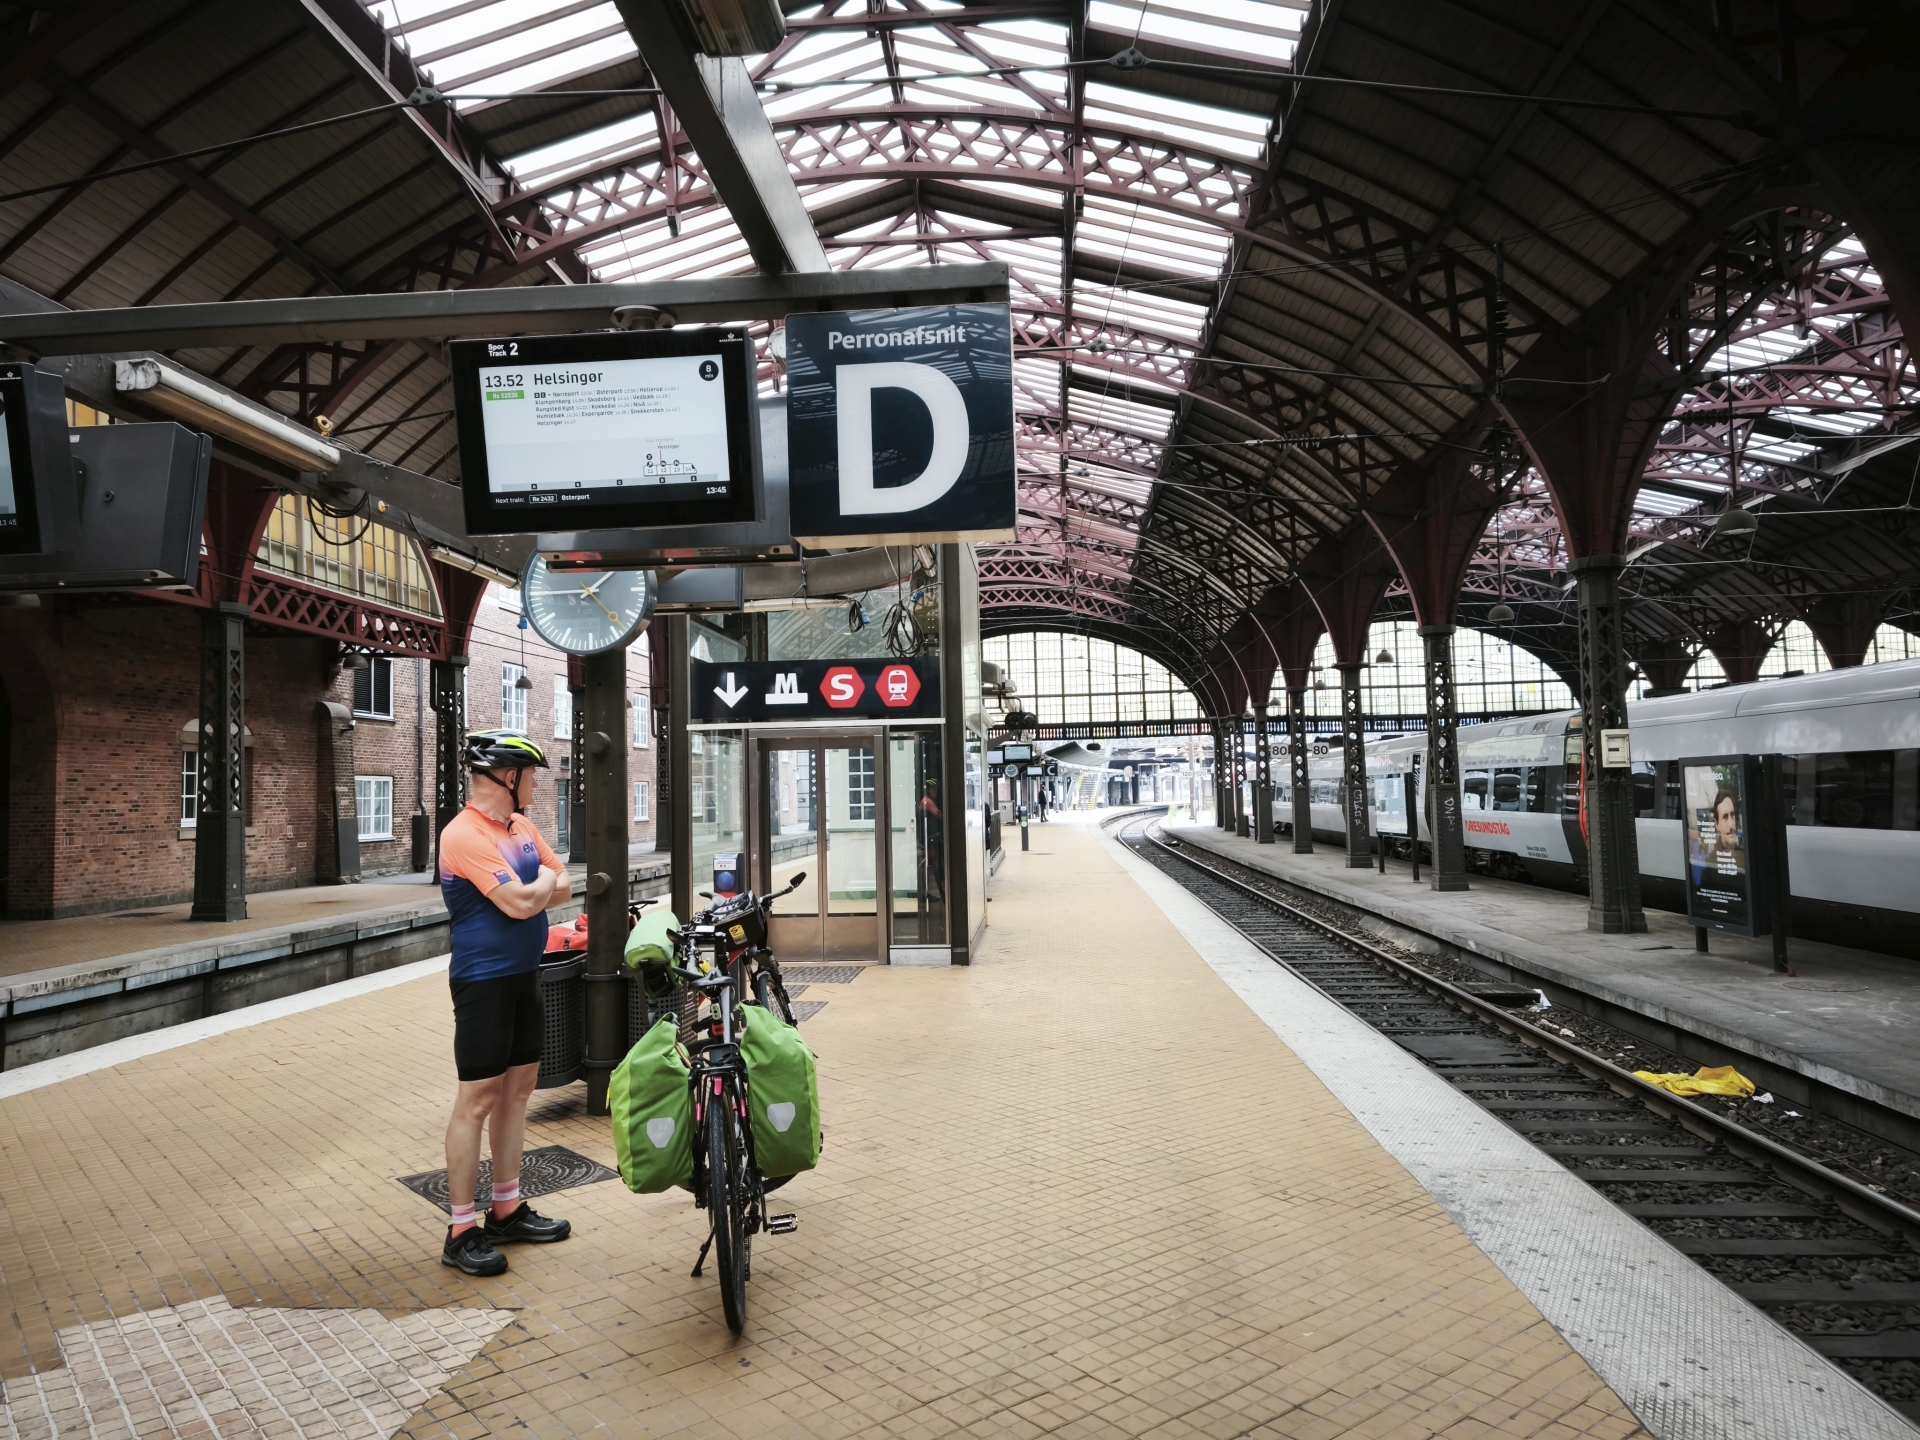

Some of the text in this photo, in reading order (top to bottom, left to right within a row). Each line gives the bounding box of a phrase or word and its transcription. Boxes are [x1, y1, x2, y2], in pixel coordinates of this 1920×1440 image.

[828, 325, 966, 350] Perronafsnit
[509, 342, 519, 356] 2
[485, 371, 603, 388] 13.52 Helsingør
[836, 361, 970, 516] D
[706, 486, 727, 494] 13:45
[561, 493, 590, 501] Østerport
[830, 673, 854, 701] S
[1272, 745, 1287, 756] 80
[1313, 745, 1329, 755] 80
[1046, 765, 1056, 776] C
[1700, 770, 1724, 781] Nordea
